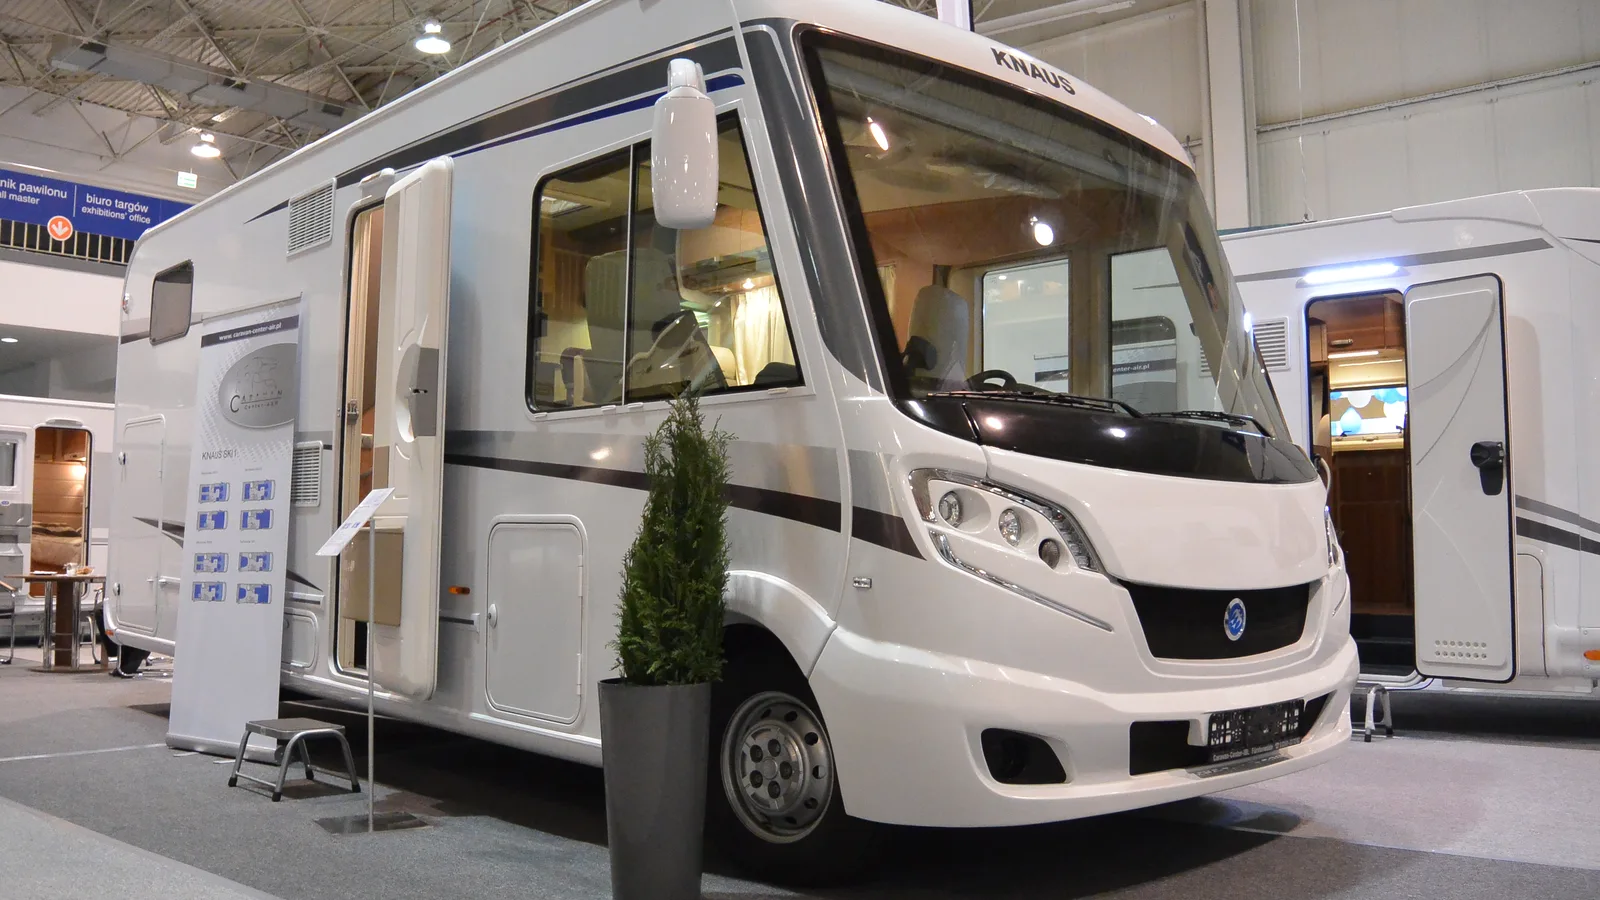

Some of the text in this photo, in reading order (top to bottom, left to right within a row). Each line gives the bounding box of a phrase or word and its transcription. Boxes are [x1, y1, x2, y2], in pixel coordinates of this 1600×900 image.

[990, 47, 1076, 96] KNAUS
[8, 193, 40, 205] master
[19, 182, 67, 199] pawilonu
[86, 193, 149, 213] biuro targów
[81, 205, 151, 224] exhibitions' office
[202, 450, 222, 460] KNAUS
